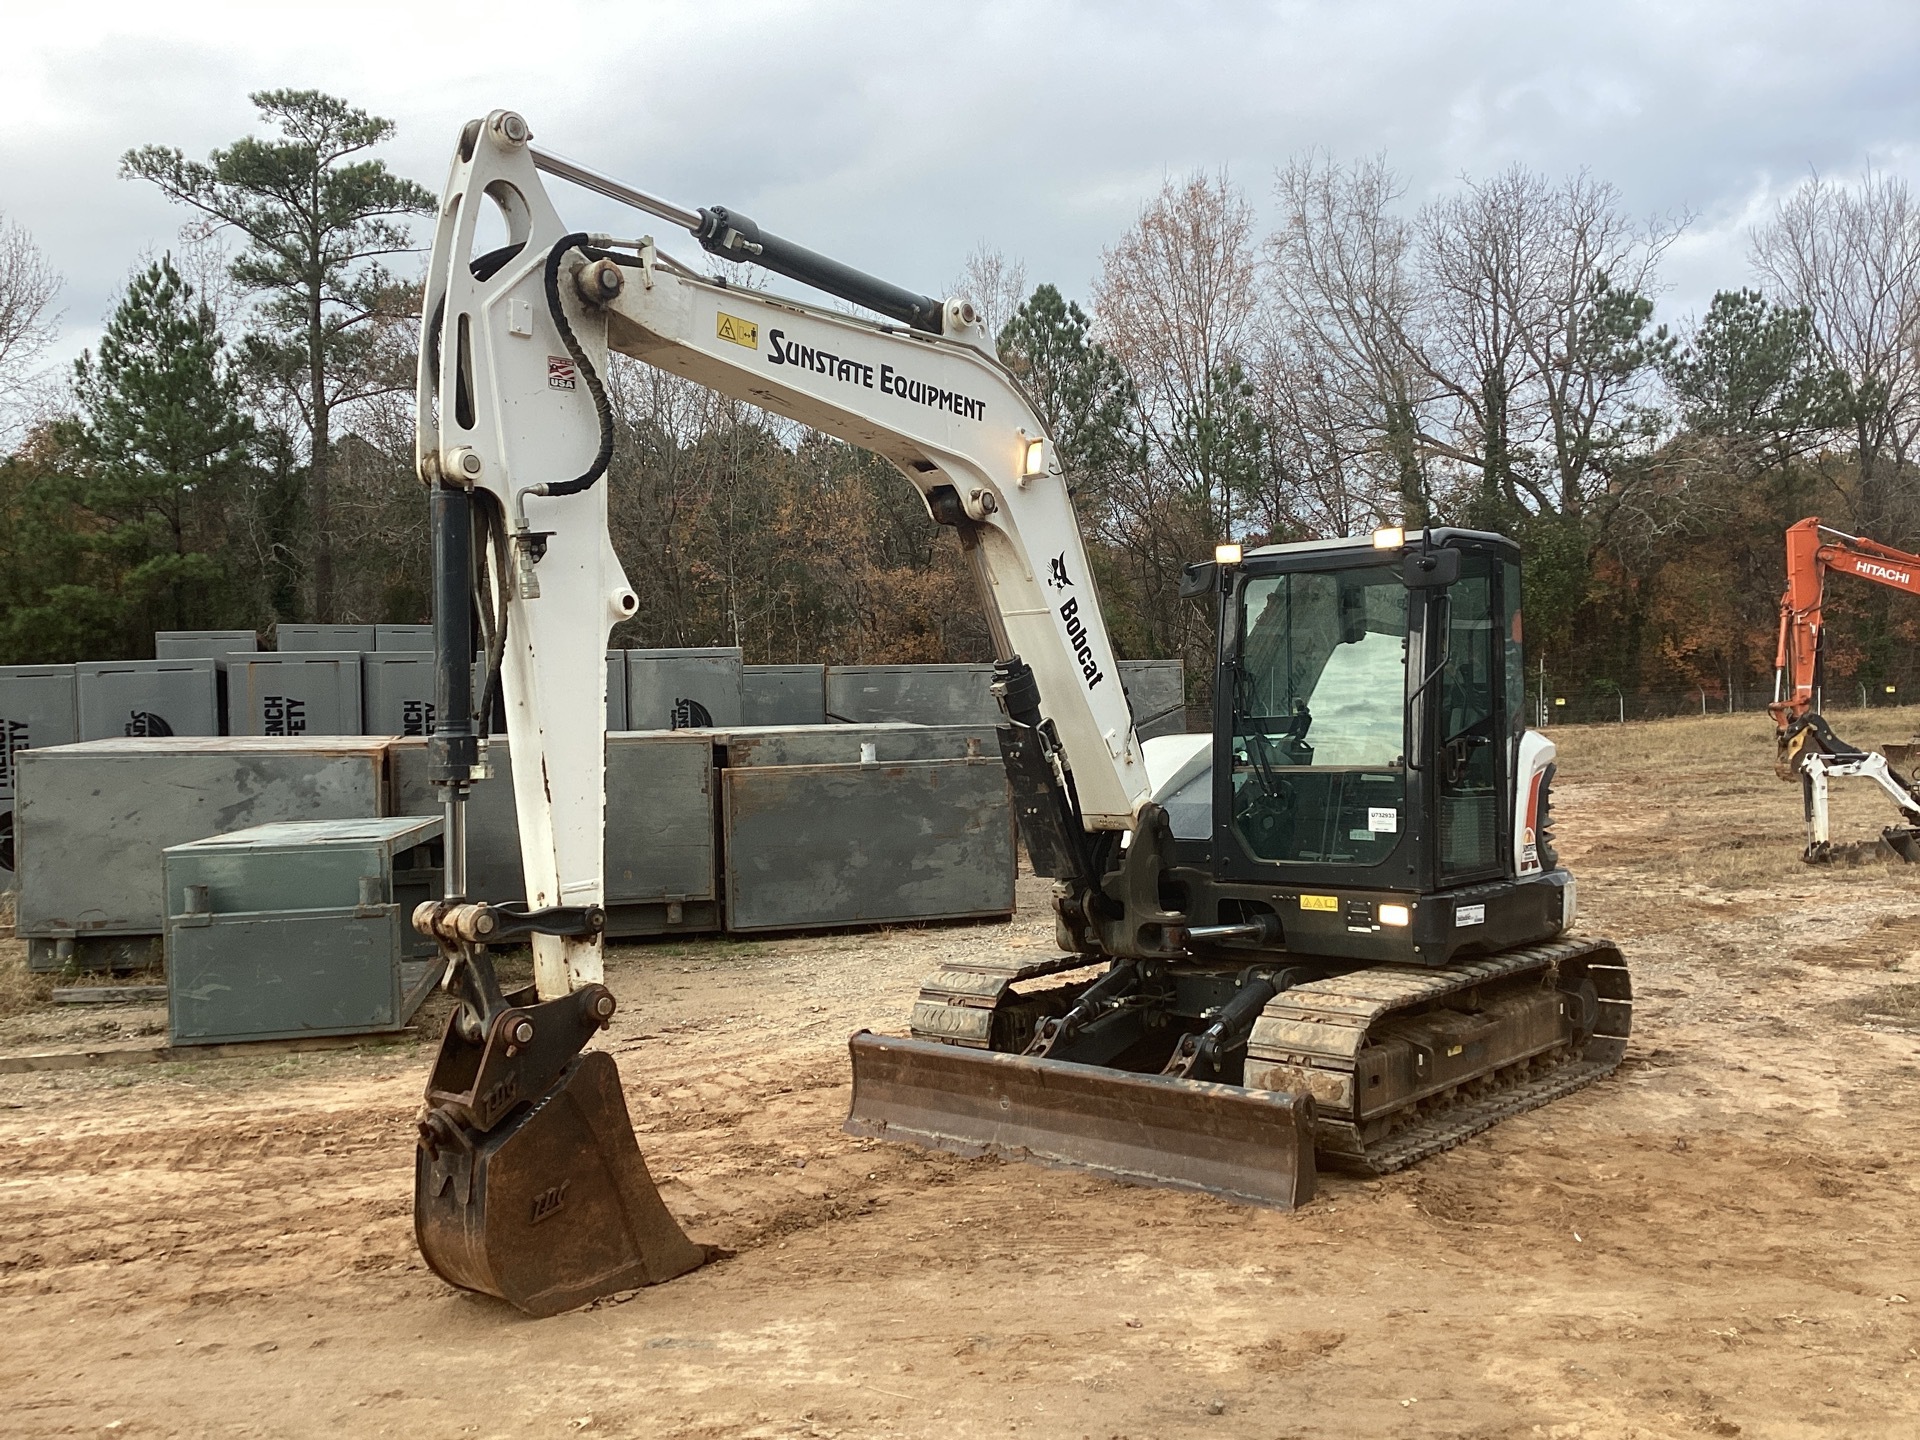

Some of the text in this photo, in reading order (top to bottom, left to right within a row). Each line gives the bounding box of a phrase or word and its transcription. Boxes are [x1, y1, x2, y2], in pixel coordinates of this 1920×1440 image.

[550, 378, 574, 389] USA
[767, 329, 987, 422] SUNSTATE EQUIPMENT
[1856, 560, 1910, 584] HITACHI
[1059, 596, 1104, 690] Bobcat
